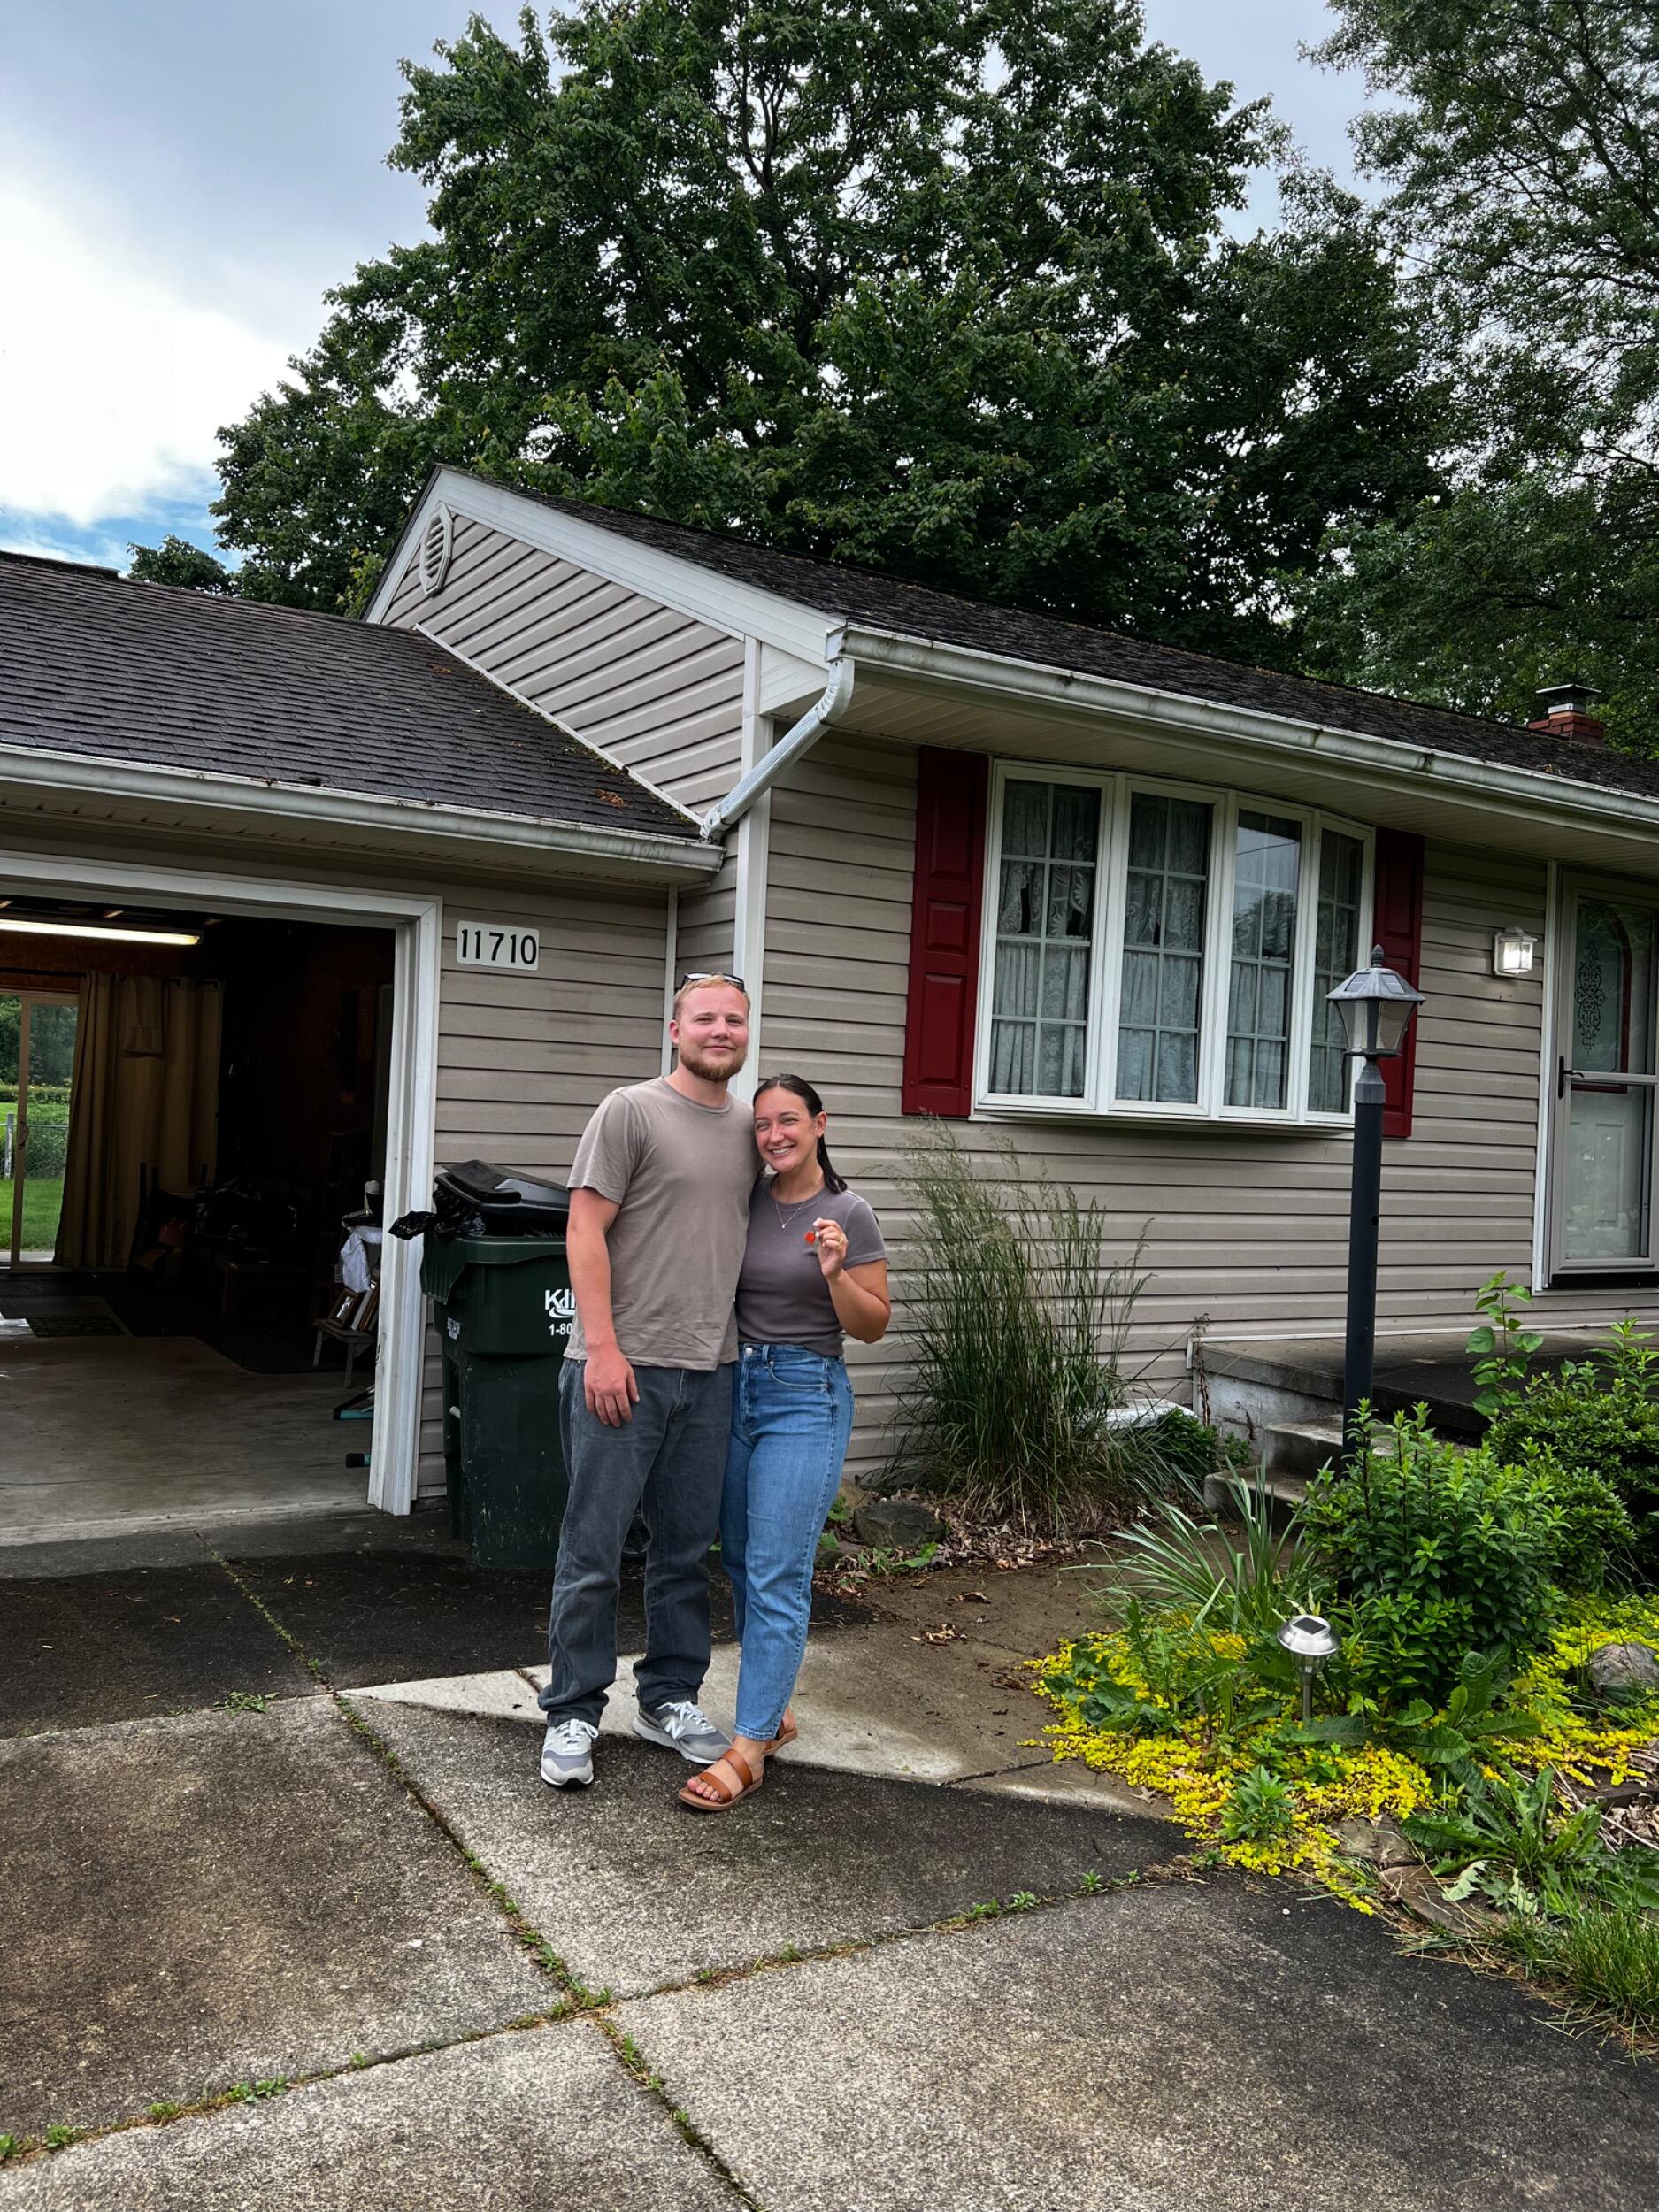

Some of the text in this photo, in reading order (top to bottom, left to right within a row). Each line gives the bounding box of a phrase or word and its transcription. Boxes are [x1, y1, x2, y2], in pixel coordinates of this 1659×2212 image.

[461, 928, 537, 964] 11710
[549, 1323, 572, 1336] 1-80
[664, 1717, 685, 1740] N
